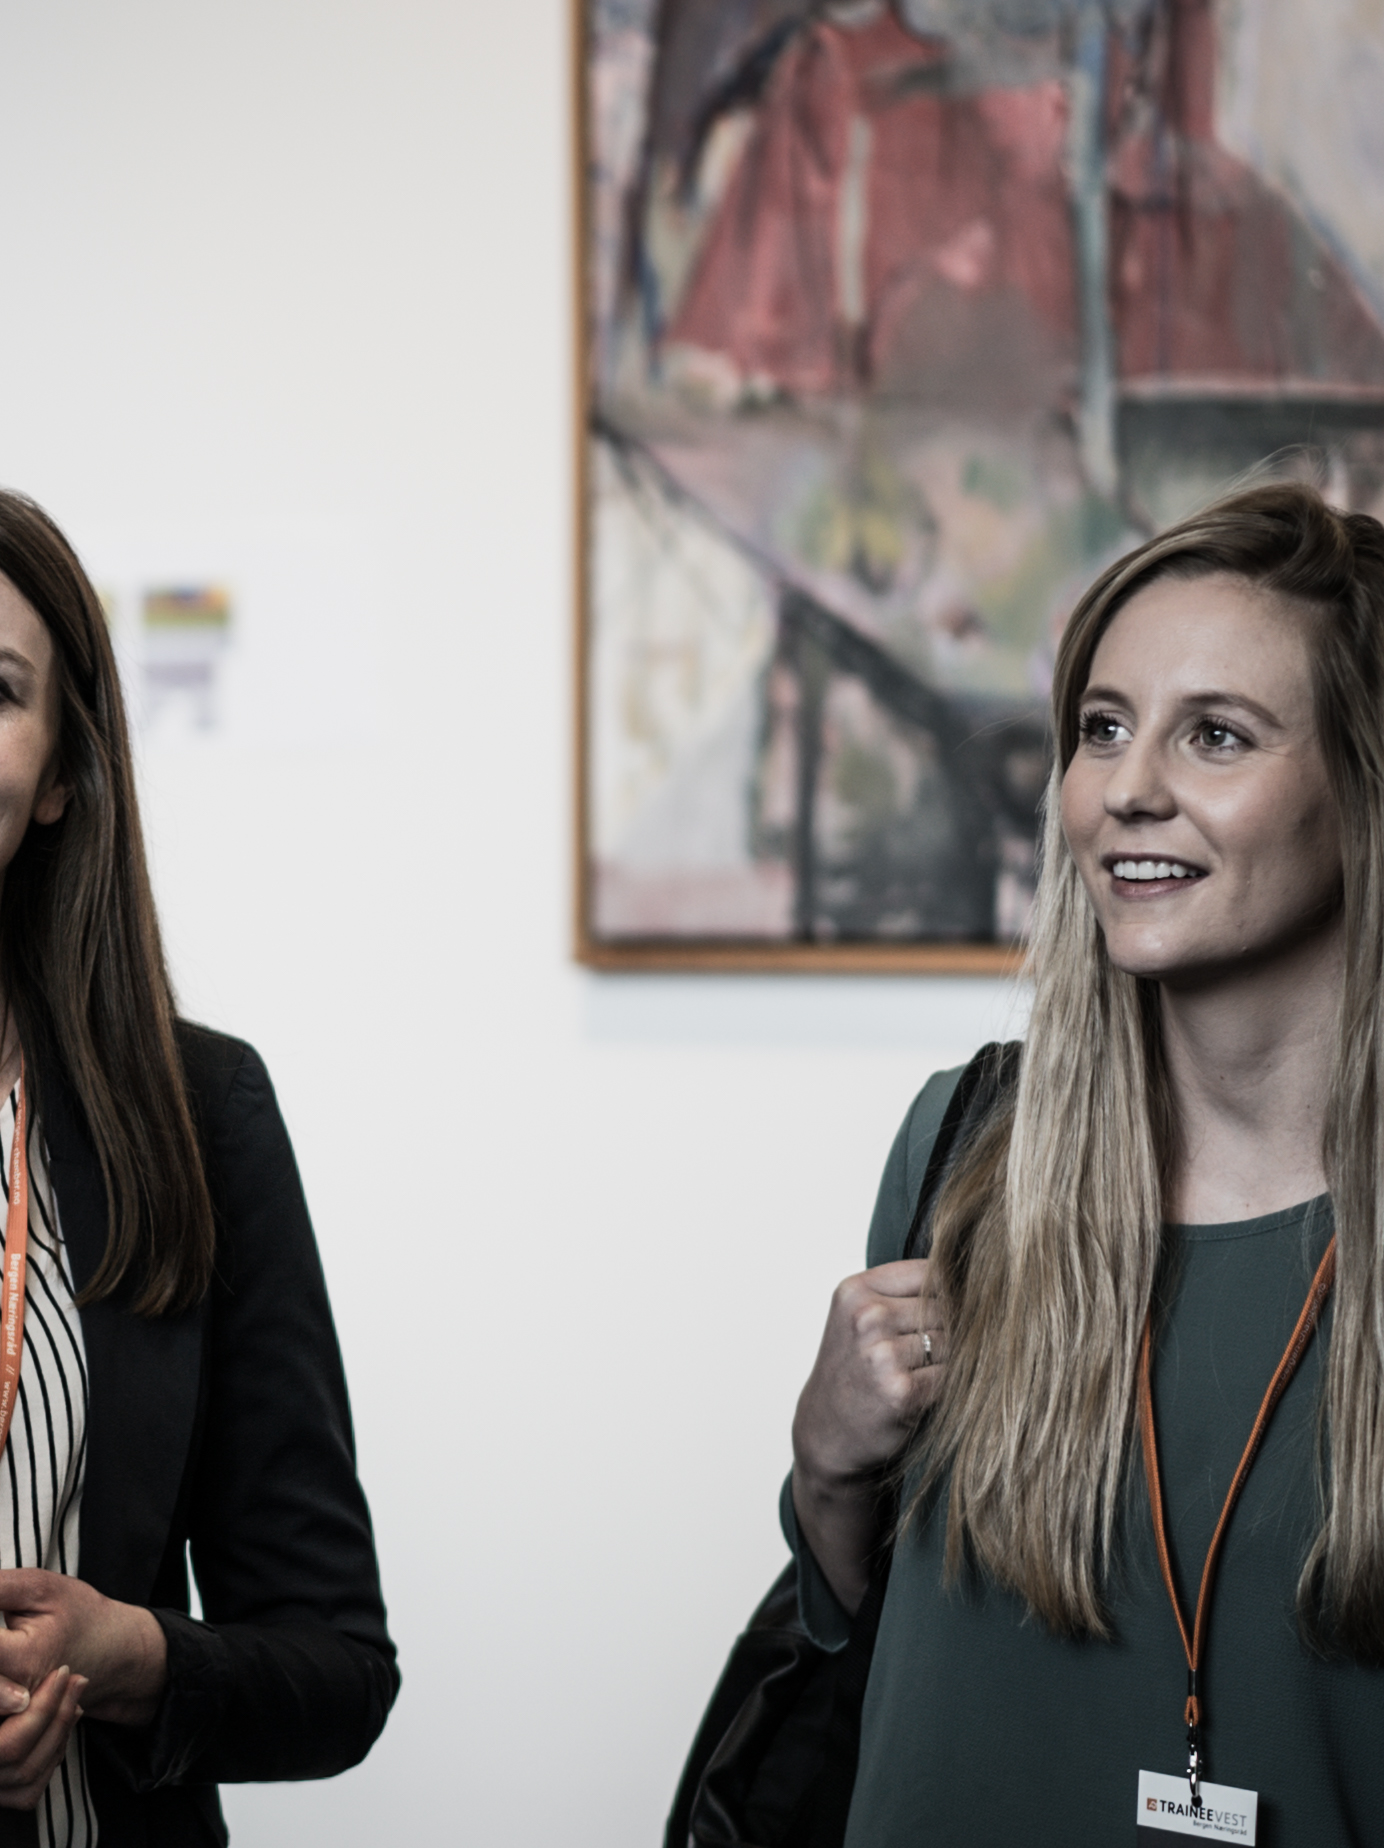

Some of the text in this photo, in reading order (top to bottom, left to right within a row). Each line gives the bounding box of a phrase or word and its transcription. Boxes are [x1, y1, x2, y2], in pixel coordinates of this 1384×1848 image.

[8, 1253, 21, 1290] Bergen
[6, 1291, 19, 1356] Næringsråd
[1159, 1799, 1247, 1827] TRAINEEVEST
[1193, 1820, 1213, 1830] Bergen
